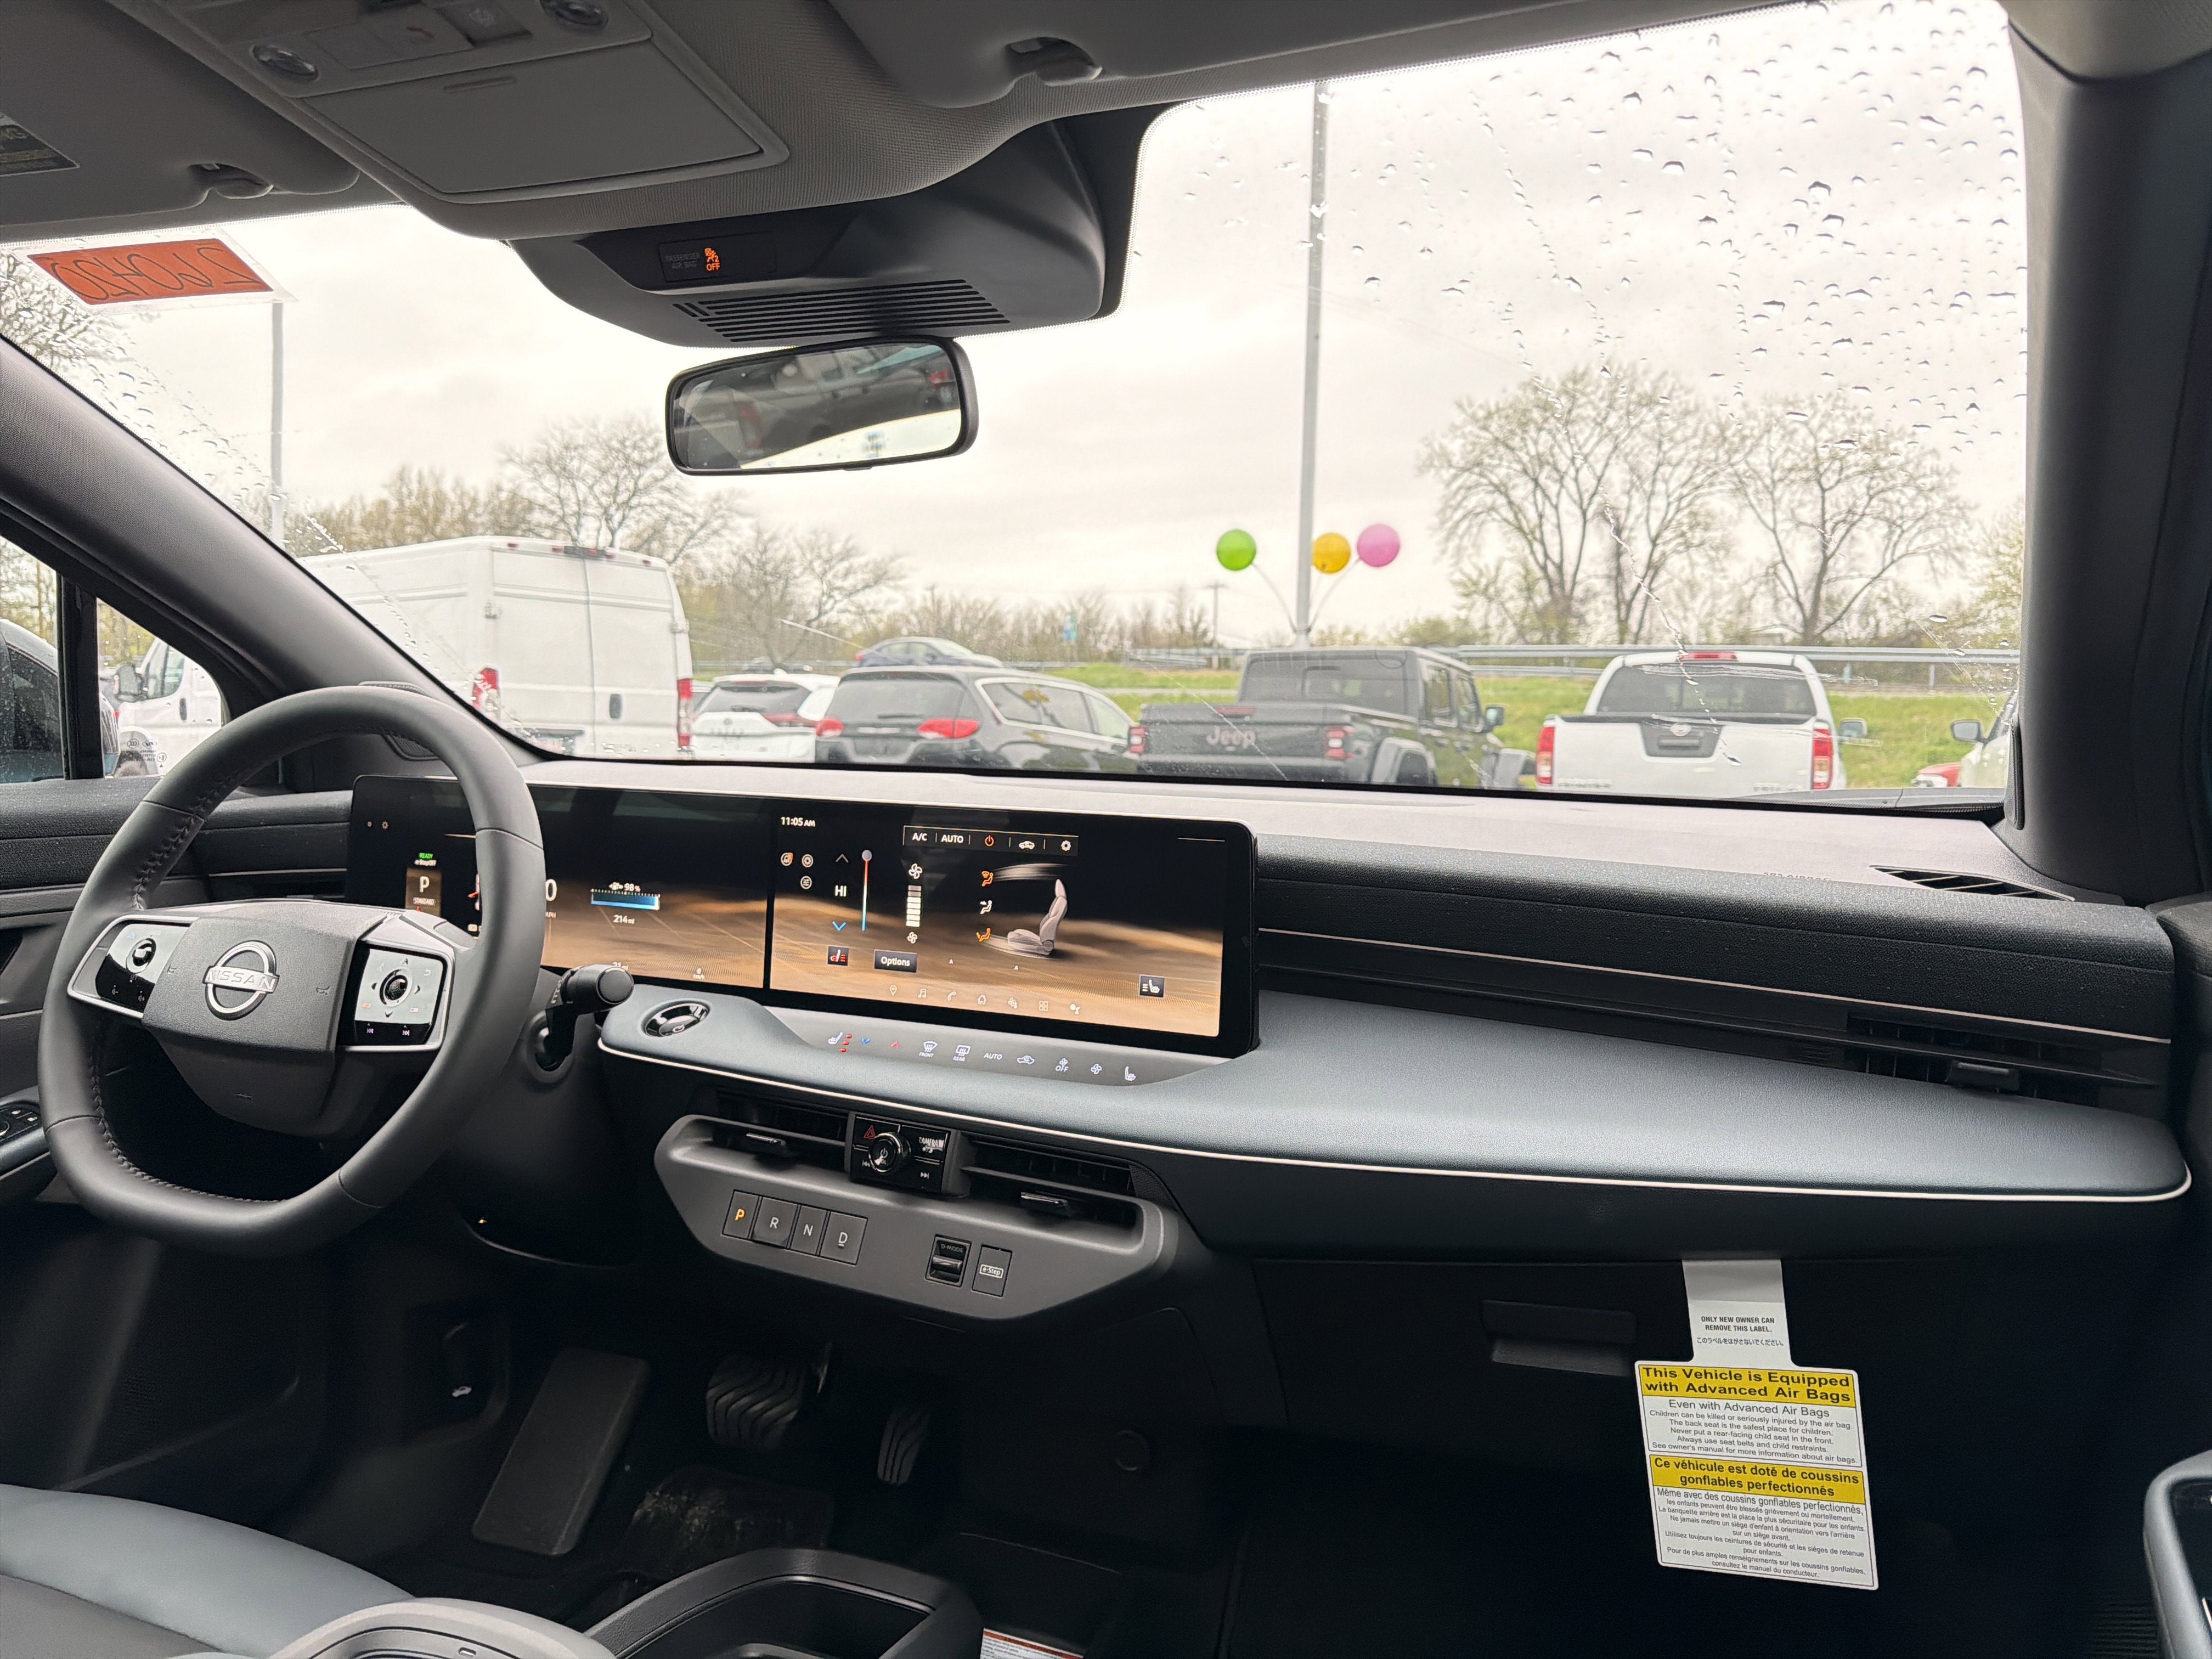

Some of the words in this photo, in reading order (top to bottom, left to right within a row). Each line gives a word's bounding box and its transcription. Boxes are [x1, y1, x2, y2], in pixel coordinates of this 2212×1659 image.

[706, 262, 720, 272] OFF
[1206, 725, 1256, 749] Jeep
[781, 816, 803, 827] 11:05
[803, 820, 816, 828] AM
[912, 832, 928, 842] A/C
[941, 833, 964, 844] AUTO
[419, 876, 430, 893] P
[545, 879, 557, 901] 0
[834, 885, 847, 897] HI
[880, 956, 911, 968] Options
[205, 969, 276, 990] NISSAN
[983, 1053, 1003, 1061] AUTO
[1055, 1064, 1069, 1073] OFF
[735, 1208, 746, 1221] P
[770, 1217, 779, 1229] R
[803, 1224, 814, 1236] N
[838, 1232, 848, 1244] D
[941, 1243, 964, 1253] D-MODE
[982, 1267, 1001, 1276] e-Step
[1642, 1367, 1677, 1378] This
[1681, 1368, 1742, 1380] Vehicle
[1748, 1370, 1762, 1381] is
[1768, 1372, 1849, 1387] Equipped
[1645, 1381, 1678, 1392] with
[1685, 1383, 1768, 1396] Advanced
[1775, 1387, 1799, 1398] Air
[1806, 1389, 1850, 1403] Bags
[1668, 1399, 1695, 1409] Even
[1699, 1401, 1720, 1410] with
[1724, 1402, 1778, 1414] Advanced
[1781, 1406, 1797, 1415] Air
[1801, 1407, 1829, 1419] Bags
[1737, 1415, 1769, 1424] seriously
[1771, 1416, 1797, 1425] injured
[1798, 1418, 1808, 1426] by
[1767, 1424, 1787, 1432] place
[1677, 1435, 1702, 1444] Always
[1713, 1431, 1752, 1440] rear-facing
[1758, 1449, 1799, 1458] information
[1654, 1457, 1670, 1468] Ce
[1673, 1459, 1724, 1472] véhicule
[1728, 1464, 1747, 1474] est
[1750, 1465, 1777, 1476] doté
[1781, 1467, 1796, 1478] de
[1801, 1471, 1859, 1483] coussins
[1680, 1475, 1743, 1488] gonflables
[1747, 1480, 1834, 1496] perfectionnés
[1657, 1487, 1681, 1497] Même
[1683, 1491, 1702, 1499] avec
[1704, 1491, 1719, 1500] des
[1720, 1494, 1756, 1504] coussins
[1758, 1497, 1801, 1508] gonflables
[1803, 1501, 1863, 1516] perfectionnés,
[1667, 1506, 1698, 1516] banquette
[1711, 1560, 1740, 1568] consultez
[1729, 1554, 1778, 1565] renseignements
[1801, 1562, 1829, 1570] coussins
